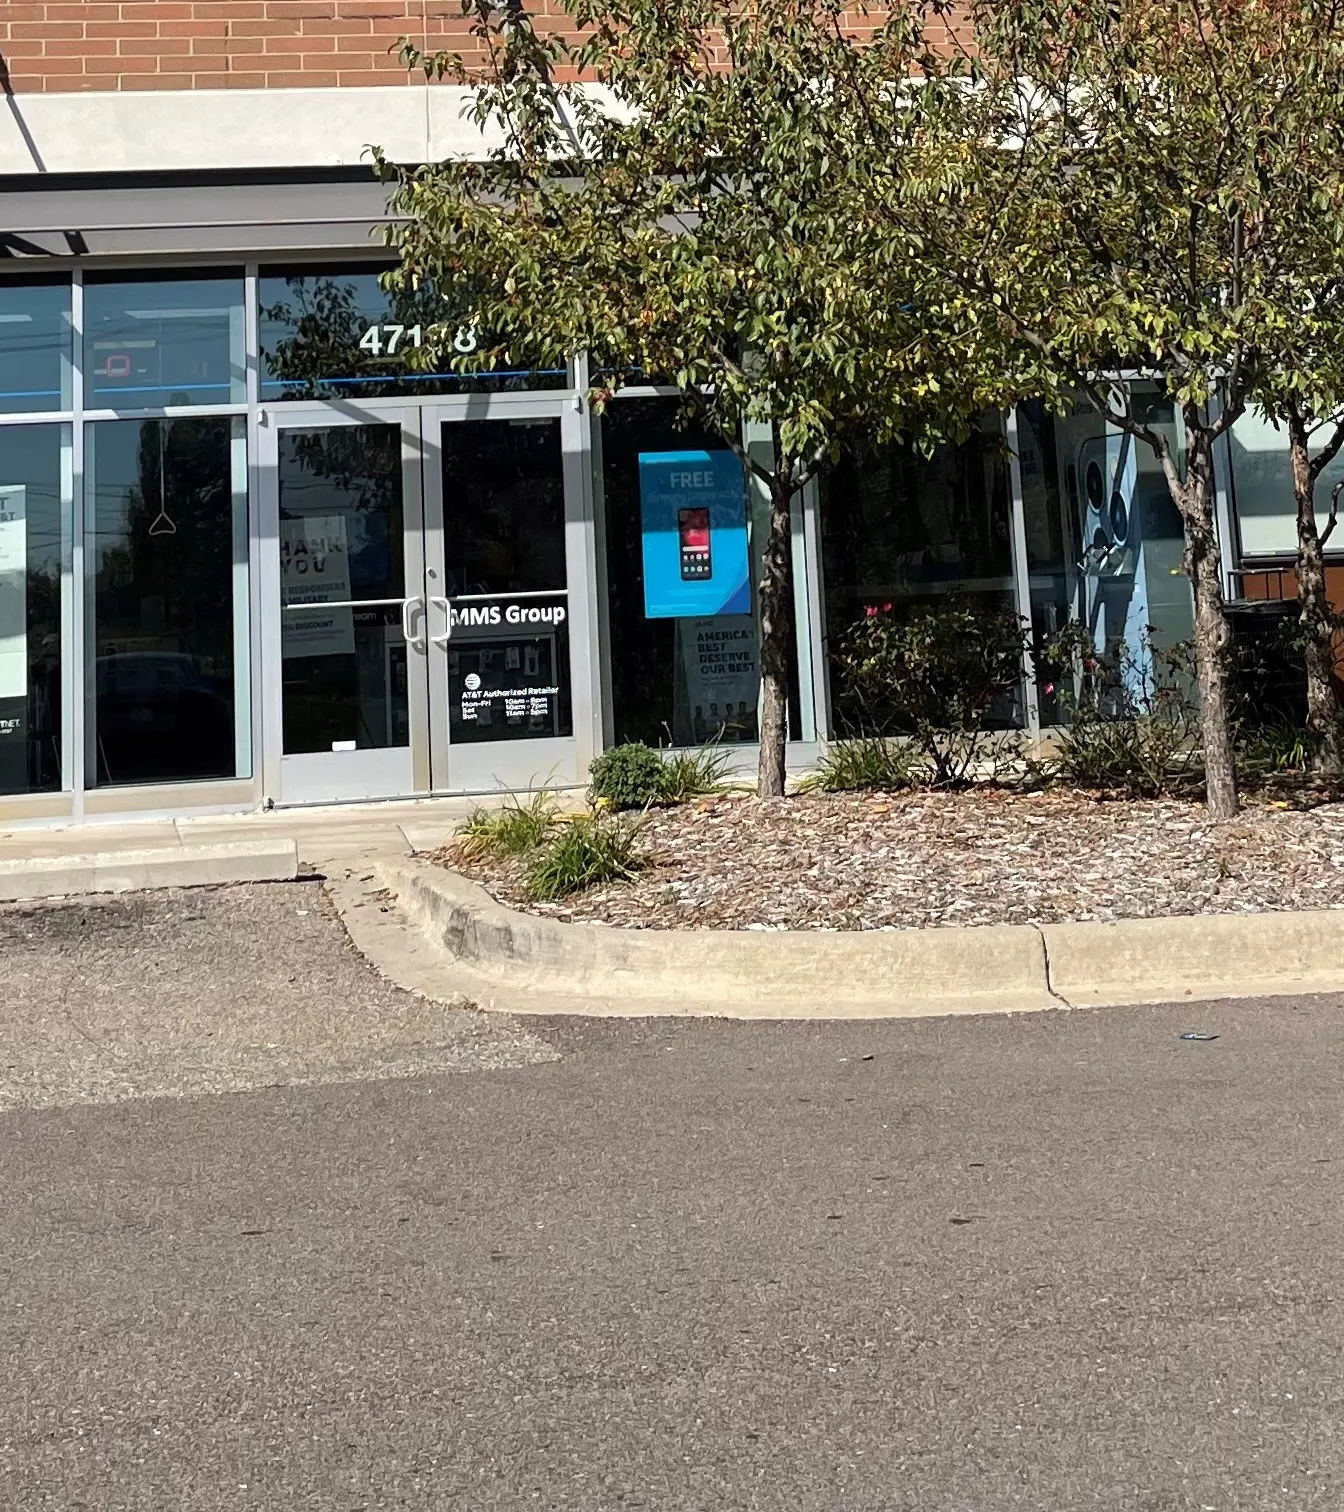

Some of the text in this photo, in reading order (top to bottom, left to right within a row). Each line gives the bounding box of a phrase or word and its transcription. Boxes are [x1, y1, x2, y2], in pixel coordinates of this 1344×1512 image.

[359, 324, 477, 354] 4718
[670, 470, 715, 489] FREE
[450, 604, 566, 626] MMS Group
[697, 642, 726, 653] BEST
[699, 651, 750, 664] DESERVE
[700, 662, 756, 674] OUR BEST
[461, 690, 483, 699] AT&T
[483, 688, 527, 698] Authorized
